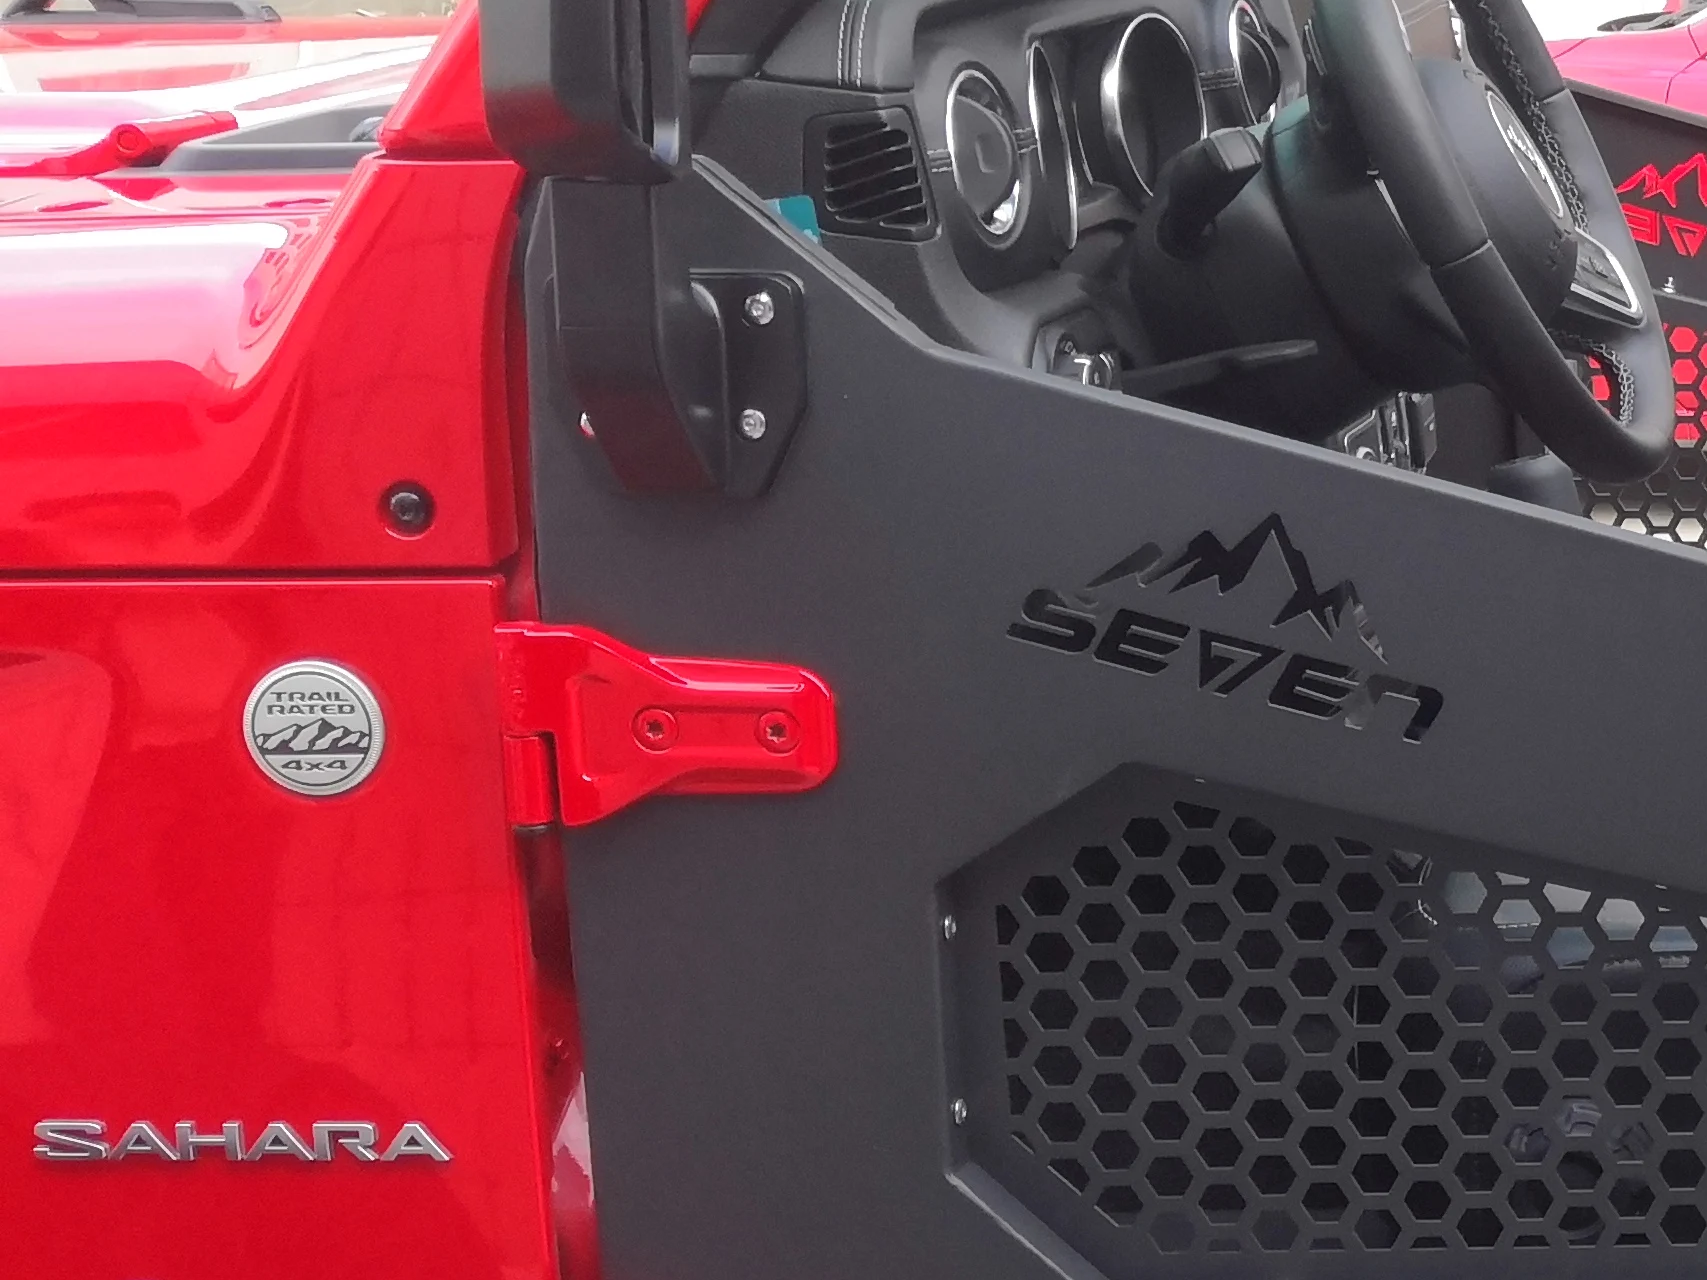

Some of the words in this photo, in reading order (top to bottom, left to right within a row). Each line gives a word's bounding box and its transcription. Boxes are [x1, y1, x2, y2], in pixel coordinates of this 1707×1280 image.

[270, 691, 349, 703] TRAIL
[266, 704, 356, 715] RATED
[281, 759, 348, 771] 4x4
[33, 1119, 454, 1161] SAHARA
